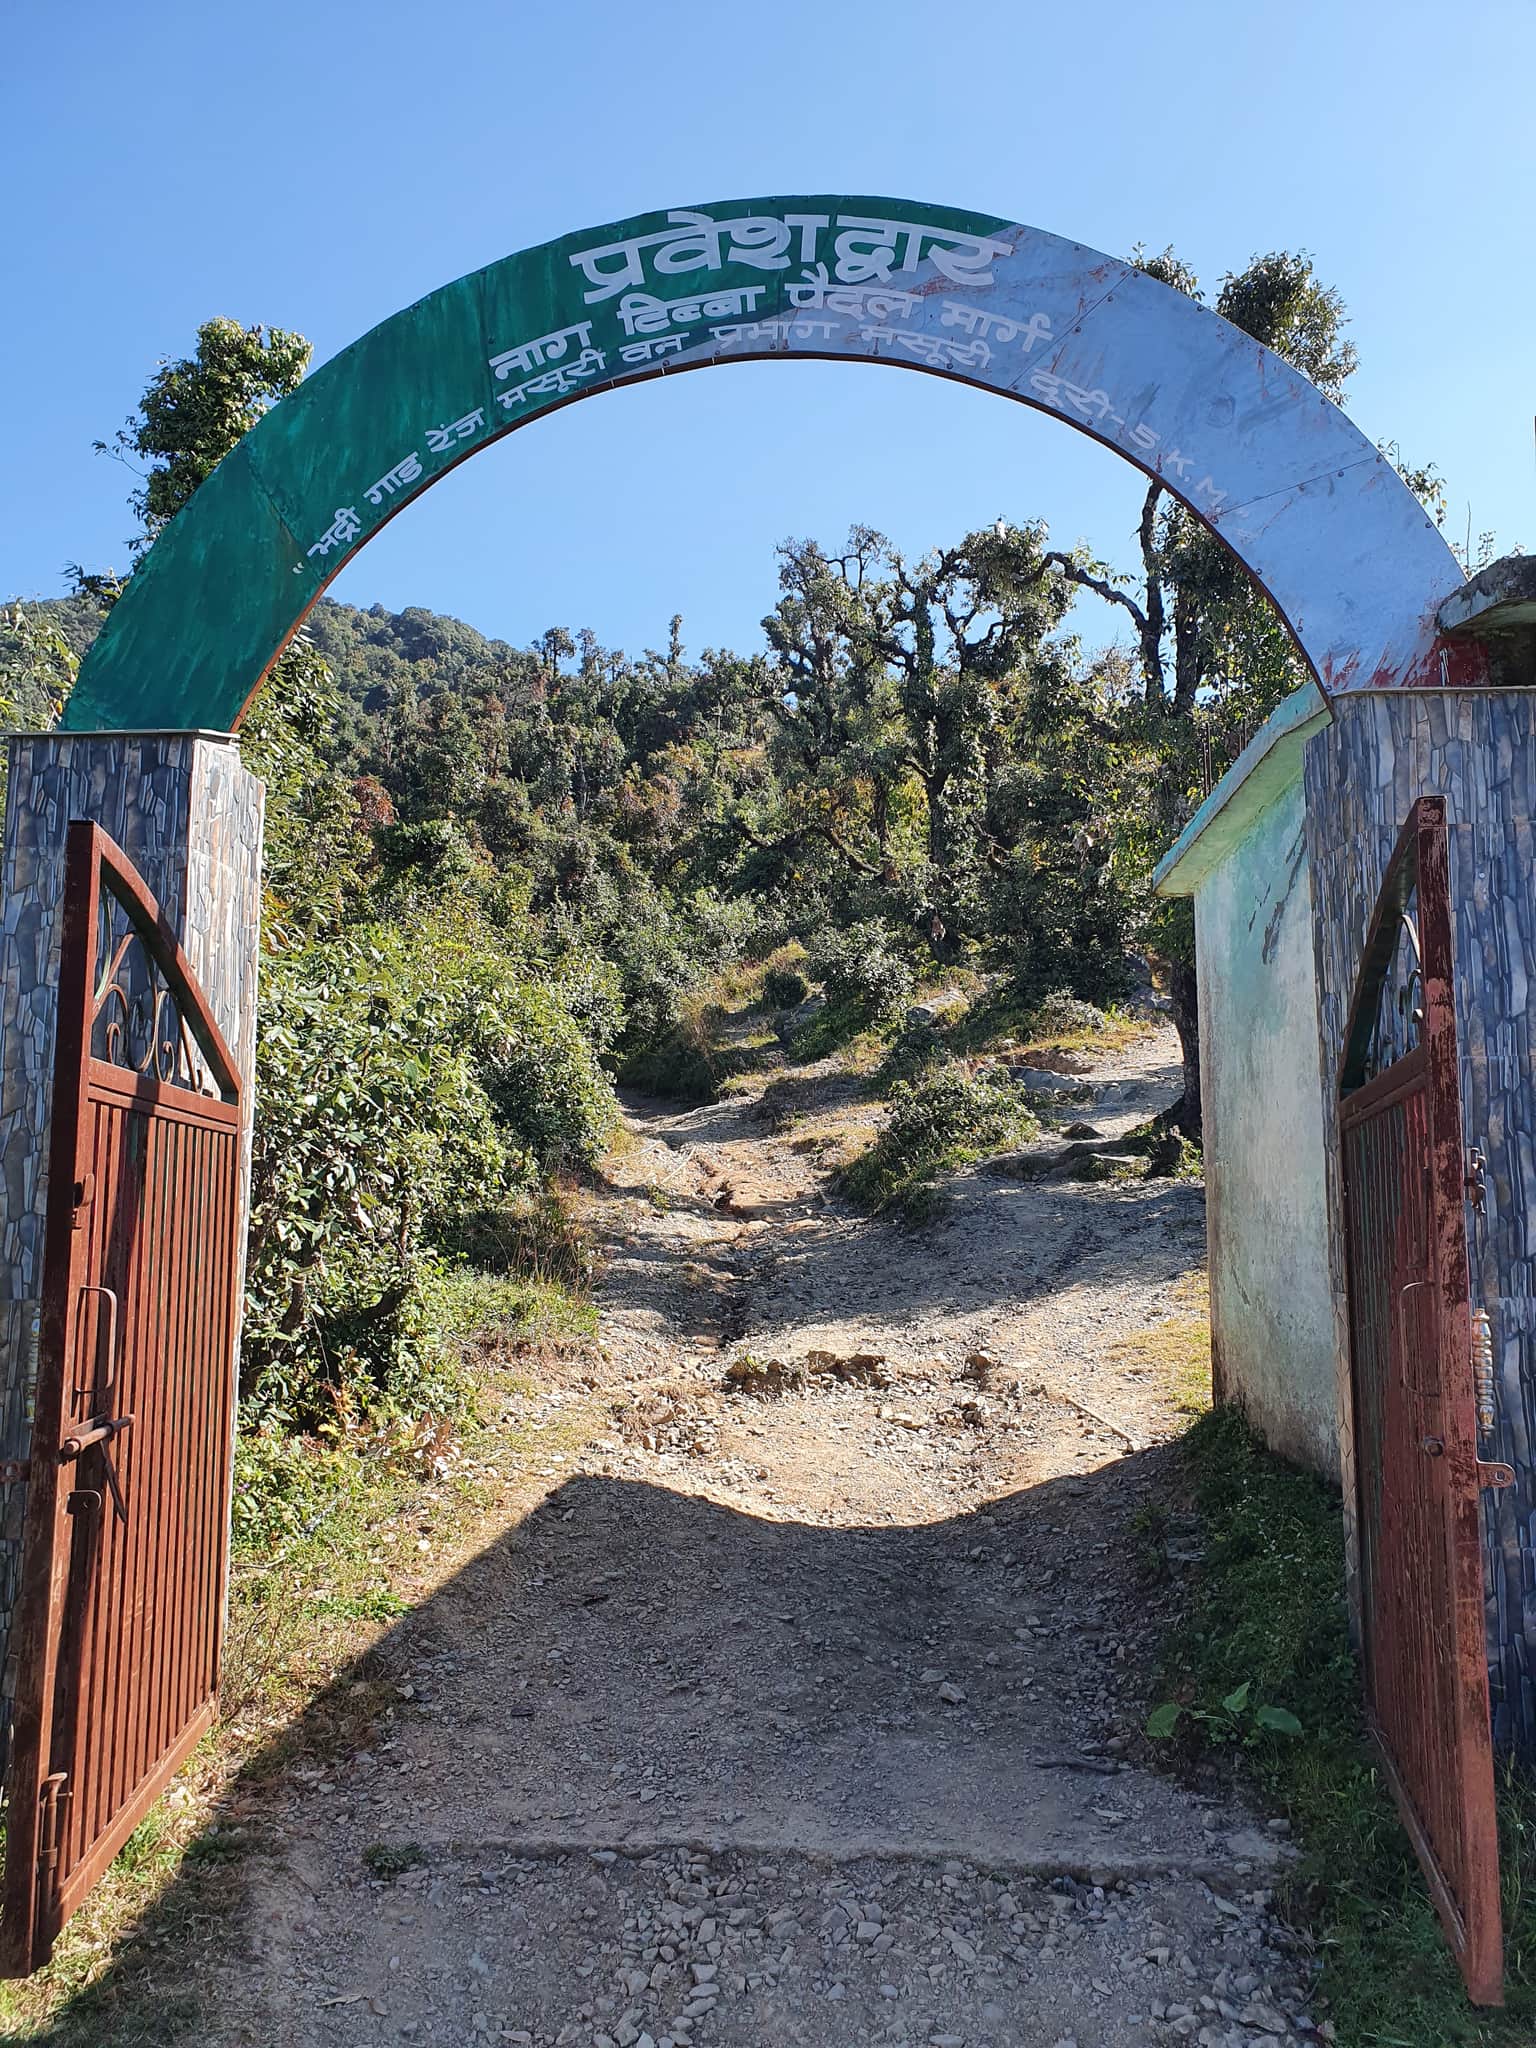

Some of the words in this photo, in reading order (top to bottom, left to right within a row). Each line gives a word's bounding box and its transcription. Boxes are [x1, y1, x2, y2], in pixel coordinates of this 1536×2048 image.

[488, 320, 593, 380] नाग
[617, 285, 766, 336] टिब्बा
[784, 263, 924, 320] पैदल
[940, 301, 1054, 353] मार्ग
[363, 451, 424, 505] गाड
[424, 407, 485, 453] रेंज
[496, 349, 607, 409] मसूरी
[618, 332, 690, 363] वन
[708, 320, 840, 351] प्रभाग
[861, 323, 996, 370] मसूरी
